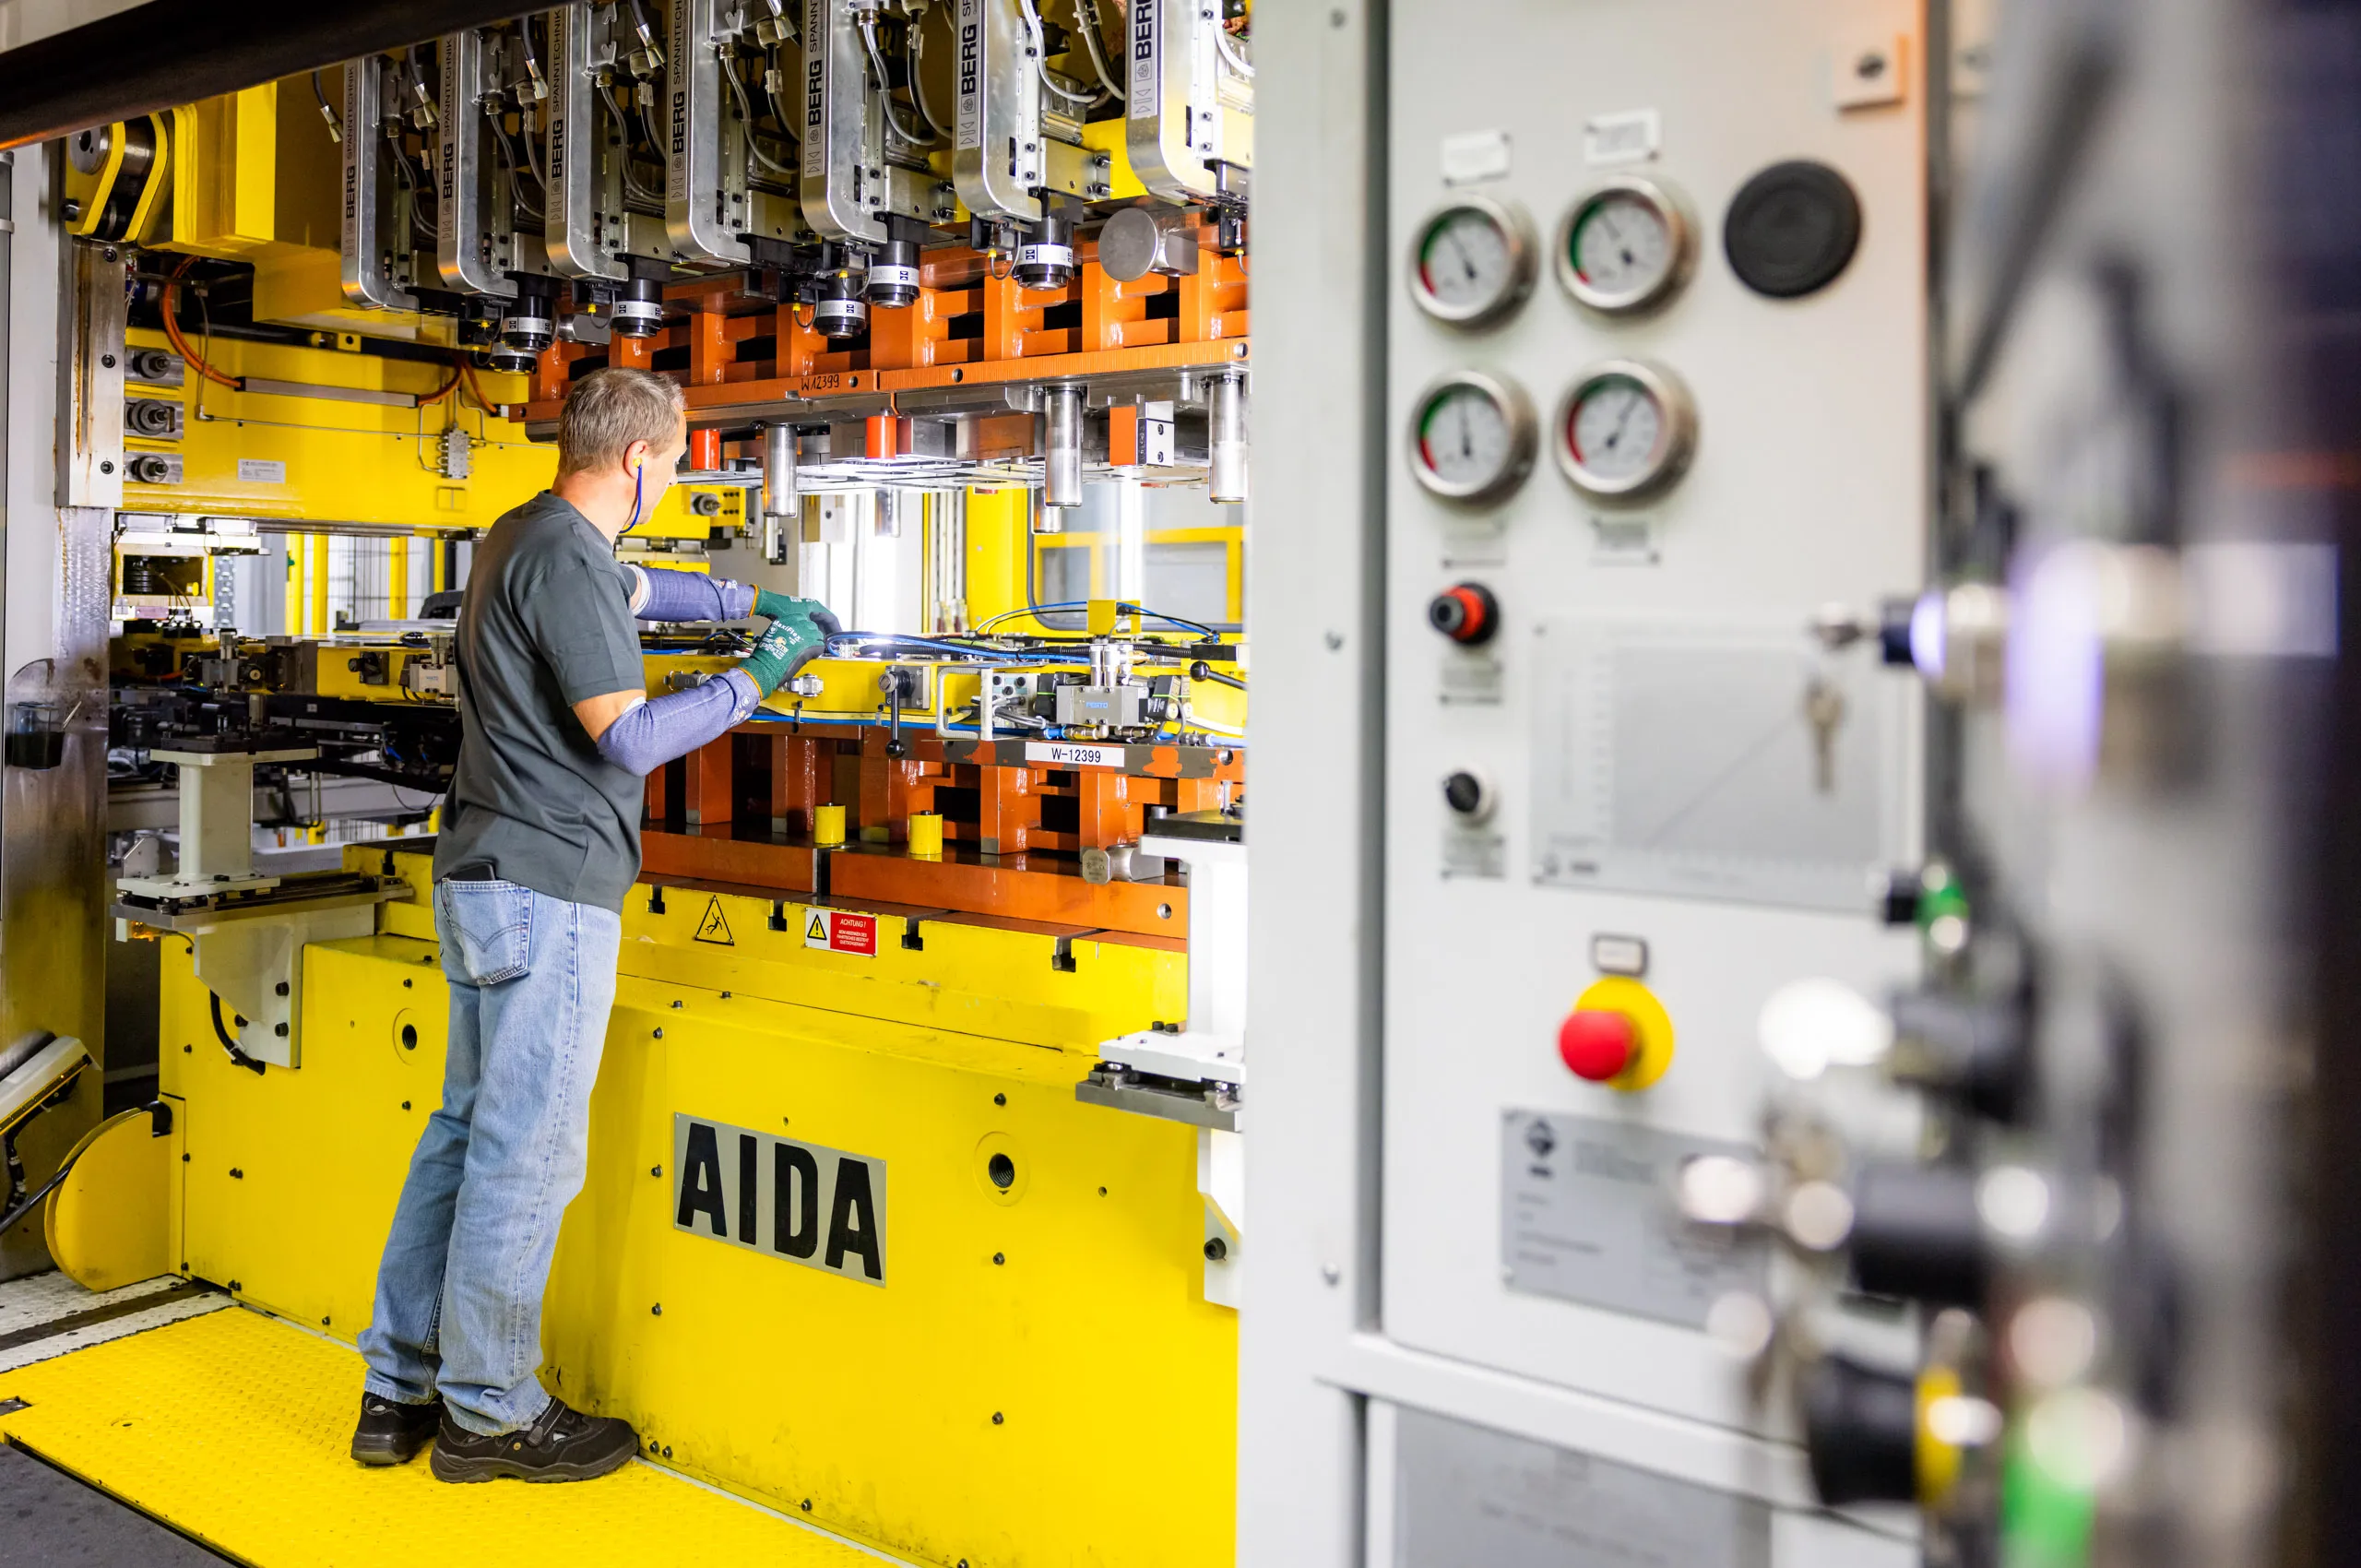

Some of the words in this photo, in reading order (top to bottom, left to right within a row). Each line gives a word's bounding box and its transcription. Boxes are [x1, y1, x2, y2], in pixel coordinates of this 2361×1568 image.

[810, 0, 818, 53] SPANN
[1135, 0, 1152, 61] BER
[444, 39, 453, 137] SPANNTECHNIK
[552, 9, 561, 113] SPANNTECHNIK
[961, 24, 978, 95] BERG
[346, 66, 355, 160] SPANNTECHNIK
[672, 91, 684, 154] BERG
[808, 59, 823, 126] BERG
[443, 143, 454, 199] BERG
[552, 119, 564, 179] BERG
[346, 165, 356, 219] BERG
[1050, 747, 1102, 764] W-12399
[677, 1122, 883, 1281] AIDA
